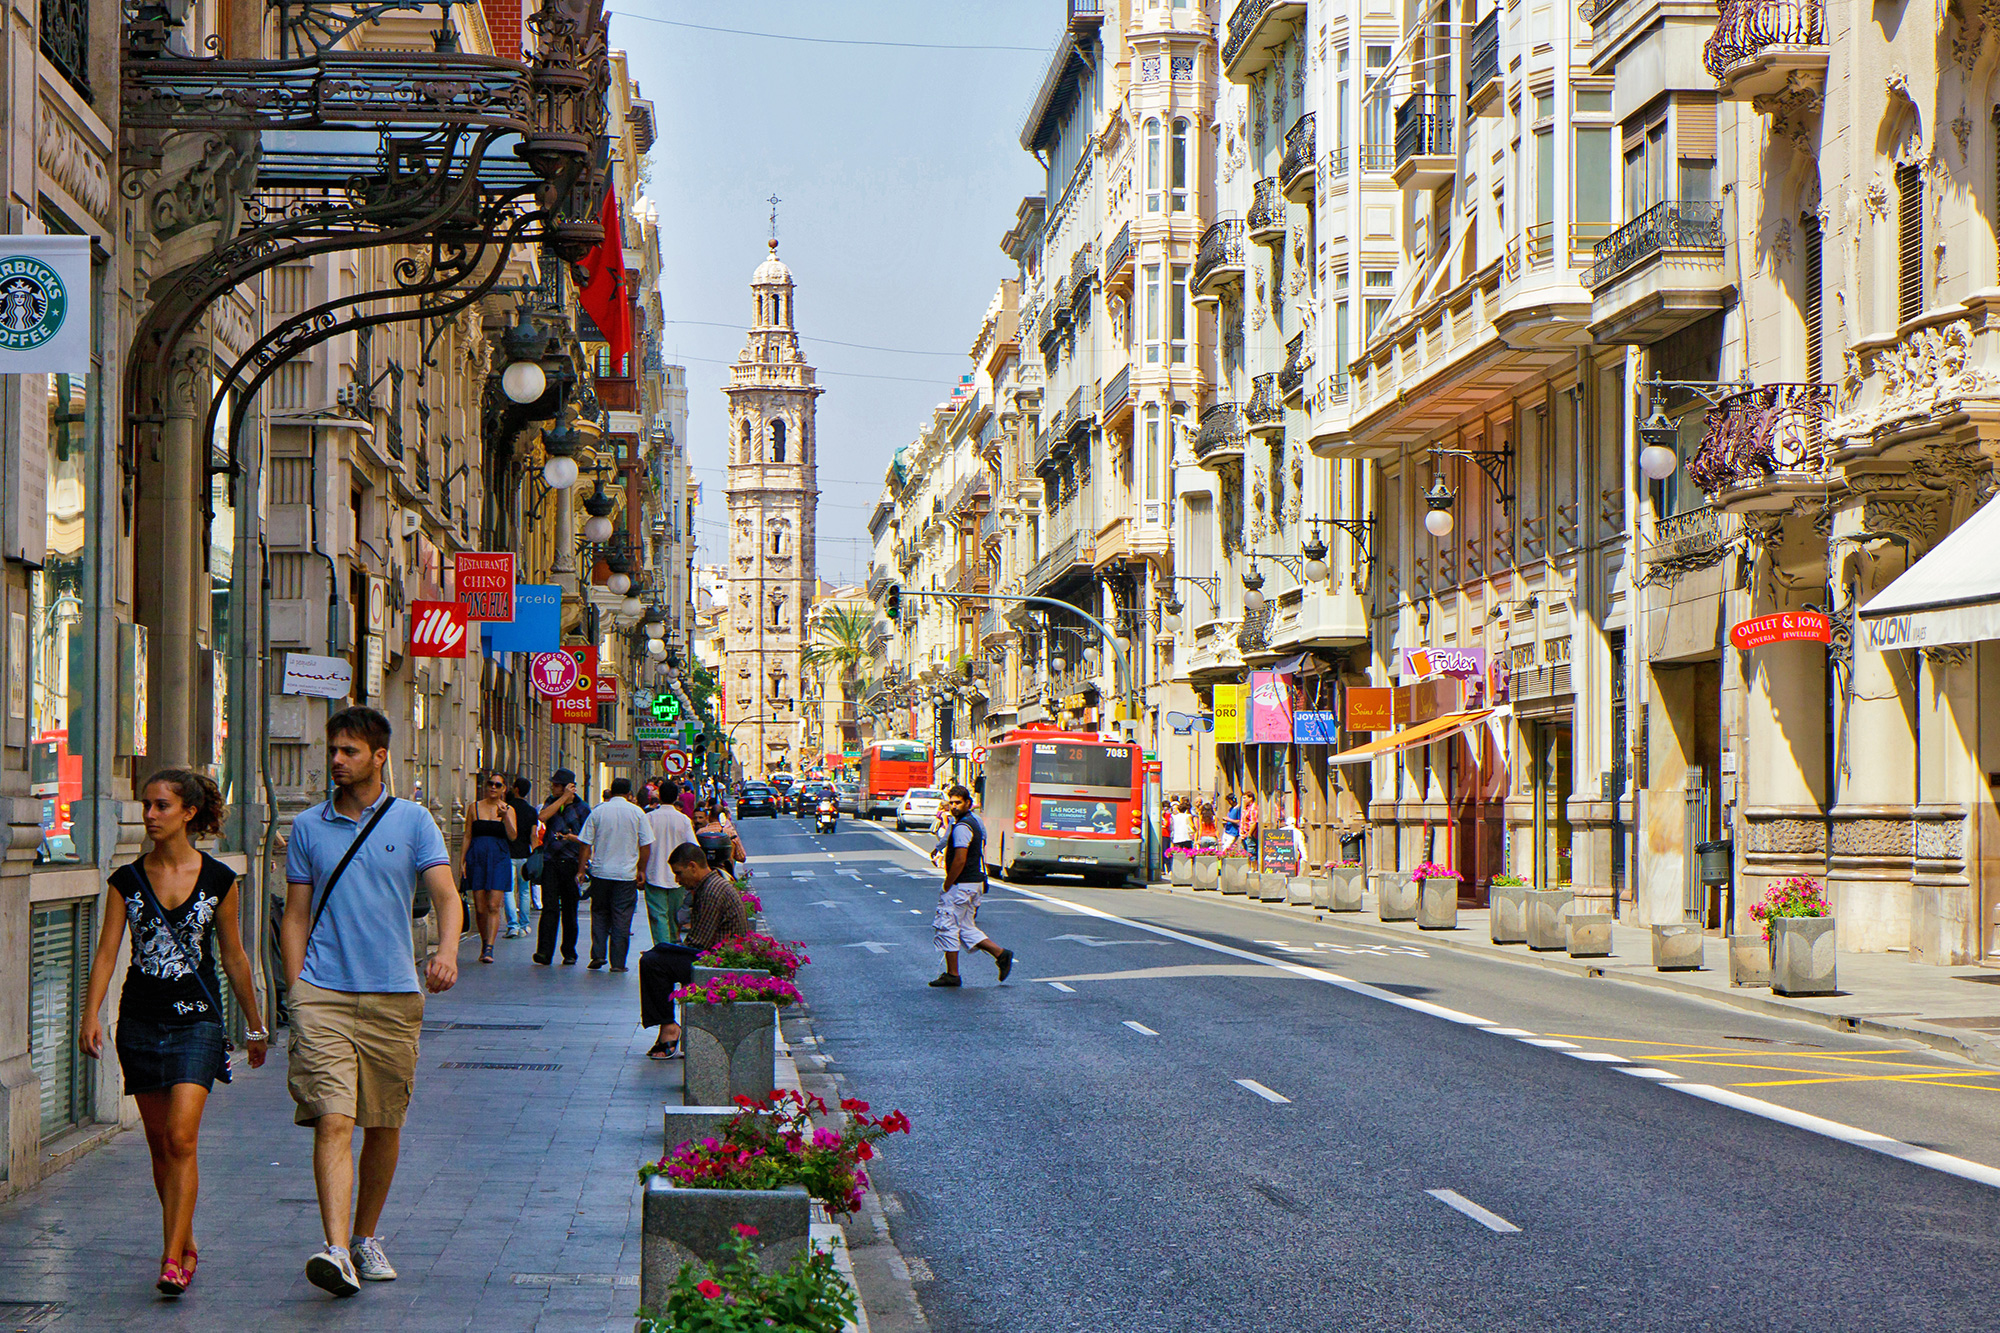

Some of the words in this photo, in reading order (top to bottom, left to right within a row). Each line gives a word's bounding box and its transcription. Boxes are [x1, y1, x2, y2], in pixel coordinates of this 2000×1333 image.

[0, 261, 62, 300] RBUCKS
[458, 556, 509, 572] RESTAURANTE
[463, 576, 507, 588] CHINO
[488, 592, 509, 617] HUA
[413, 608, 465, 653] illy
[1737, 618, 1777, 637] OUTLET
[1782, 615, 1793, 629] &
[1797, 616, 1823, 629] JOYA
[1869, 616, 1912, 646] KUONI
[1747, 634, 1775, 646] JOYERIA
[1782, 631, 1820, 639] JEWELLERY
[538, 653, 571, 665] cupcake
[1427, 650, 1476, 671] Folder
[537, 679, 571, 691] valencia
[557, 696, 591, 709] nest
[1350, 703, 1373, 716] Soins
[1215, 709, 1237, 717] ORO
[1297, 712, 1334, 721] JOYERÍA
[1069, 749, 1083, 760] 26
[1105, 748, 1129, 758] 7083
